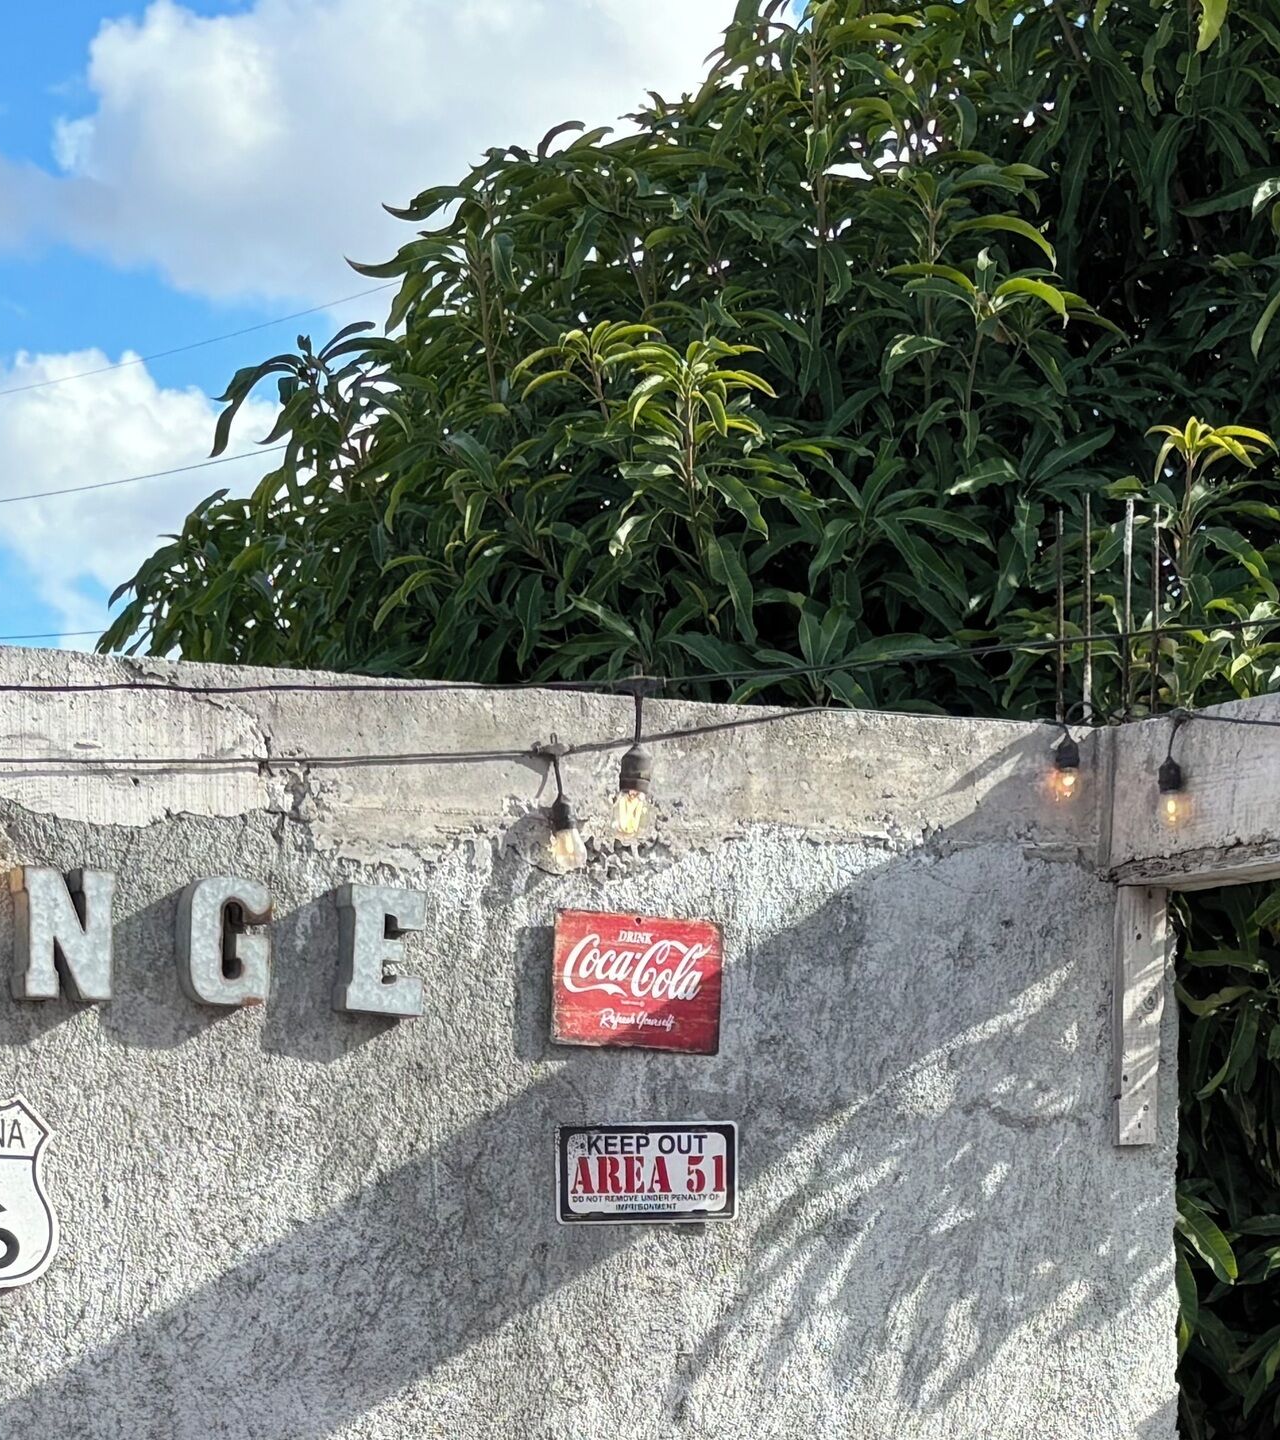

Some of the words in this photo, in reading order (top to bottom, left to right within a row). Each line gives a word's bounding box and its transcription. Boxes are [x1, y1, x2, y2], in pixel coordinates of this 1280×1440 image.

[619, 930, 654, 945] DRINK
[563, 933, 712, 1001] Coca-Cola
[587, 1135, 650, 1155] KEEP
[658, 1134, 708, 1154] OUT
[571, 1156, 673, 1194] AREA
[686, 1155, 726, 1193] 51
[572, 1195, 585, 1203] DO
[586, 1195, 602, 1203] NOT
[604, 1194, 638, 1202] REMOVE
[671, 1193, 708, 1201] PENALTY
